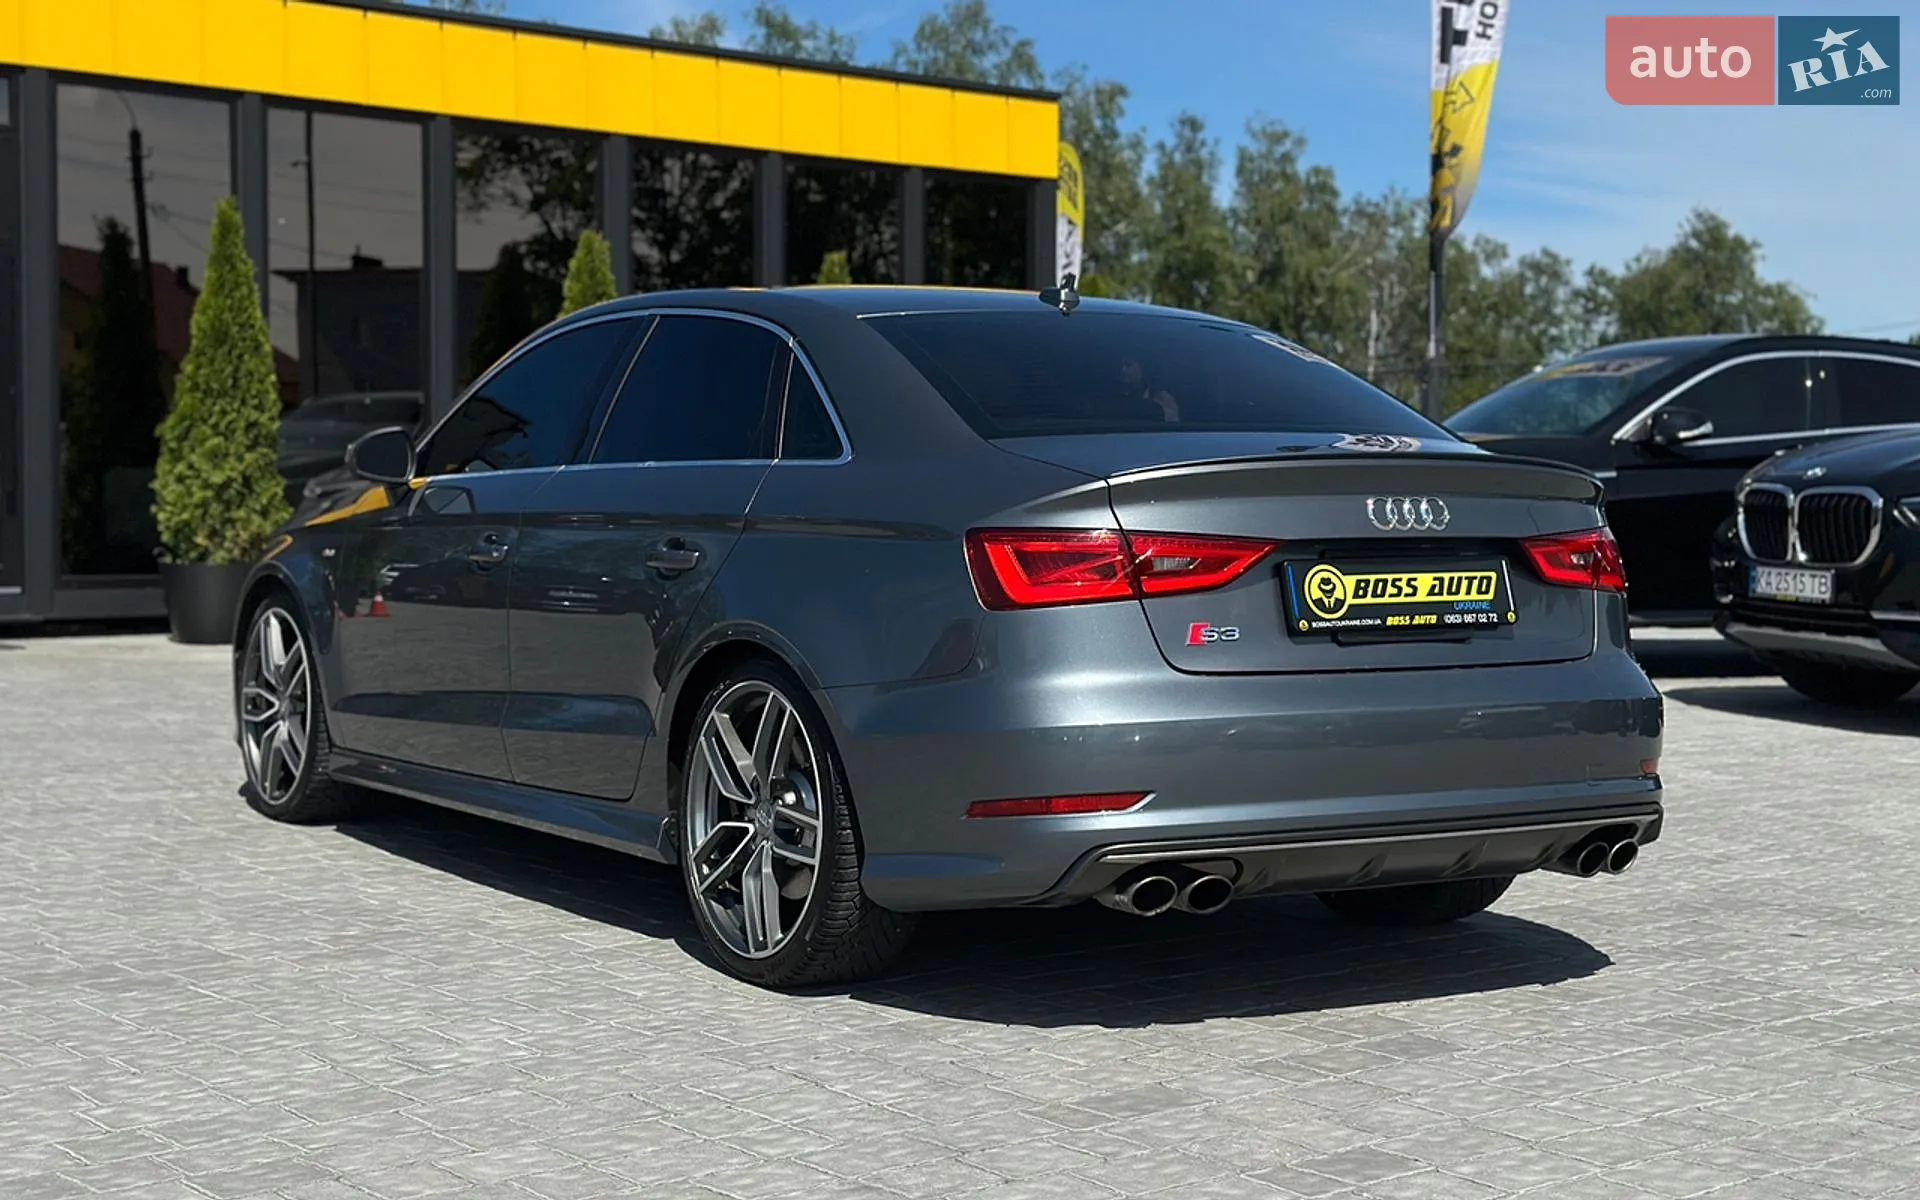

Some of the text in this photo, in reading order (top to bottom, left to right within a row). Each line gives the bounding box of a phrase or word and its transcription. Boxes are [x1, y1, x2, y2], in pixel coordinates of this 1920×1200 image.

[1352, 575, 1493, 600] BOSS AUTO
[1454, 601, 1491, 611] UKRAINE
[1386, 614, 1438, 626] BOSS AUTO
[1478, 612, 1488, 623] 02
[1488, 612, 1499, 623] 72
[1200, 626, 1240, 642] S3
